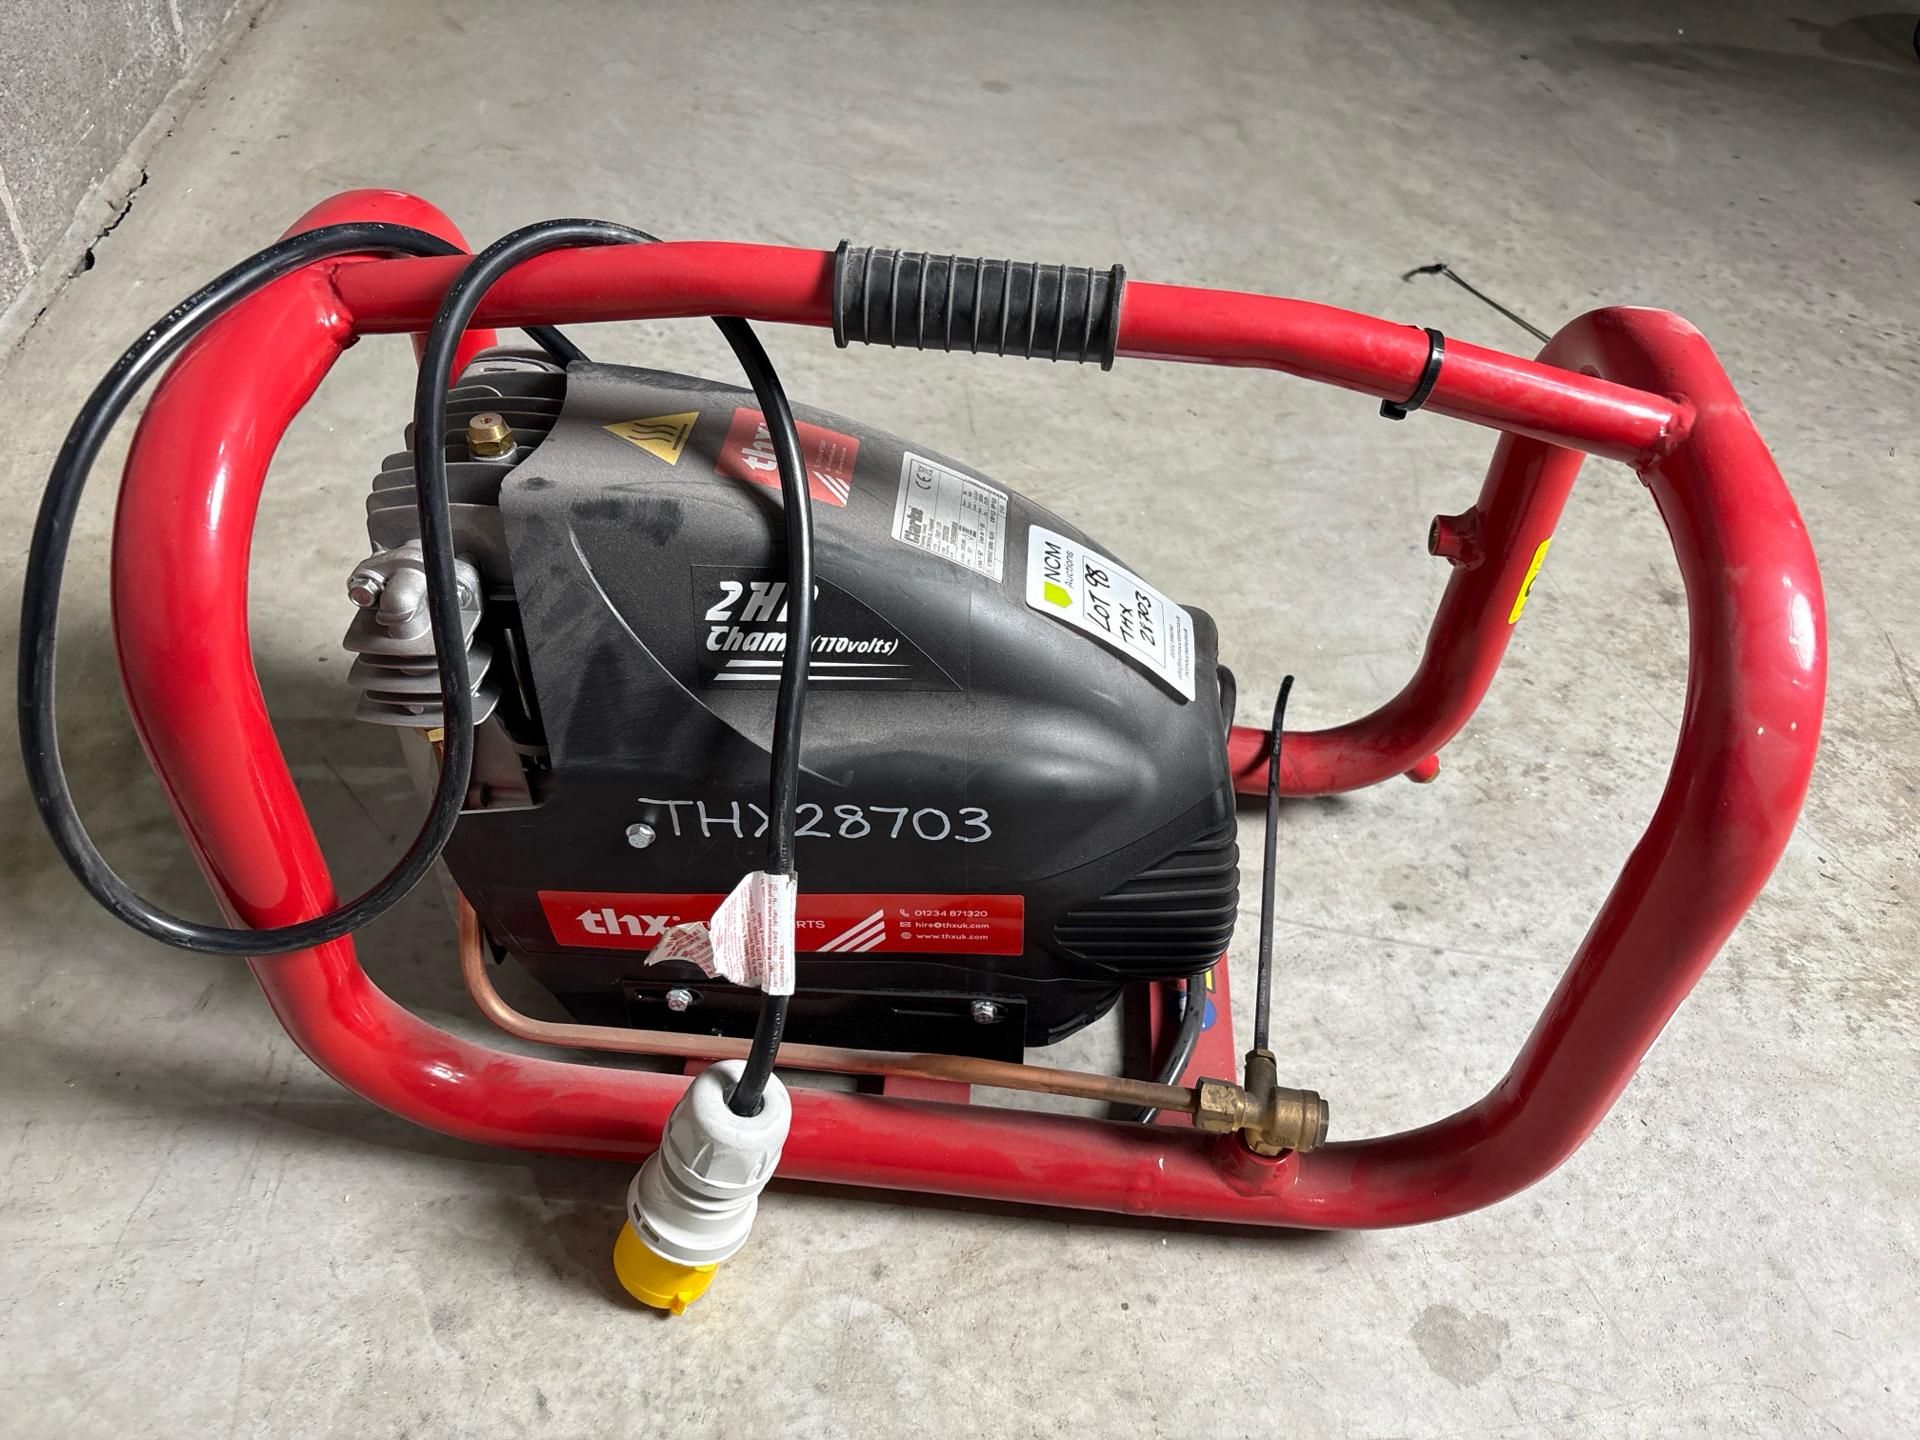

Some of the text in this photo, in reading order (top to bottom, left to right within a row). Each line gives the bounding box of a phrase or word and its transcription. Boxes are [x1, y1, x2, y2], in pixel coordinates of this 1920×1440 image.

[1044, 541, 1062, 583] NCM
[1064, 550, 1074, 589] Auctions
[1085, 563, 1111, 633] LOT 98
[1119, 603, 1134, 643] THX
[1135, 590, 1156, 647] 28703
[810, 635, 899, 656] (110volts)
[914, 909, 988, 918] 01234 871320
[915, 921, 990, 930] hire@thxuk.com
[915, 932, 989, 941] www.thxuk.com
